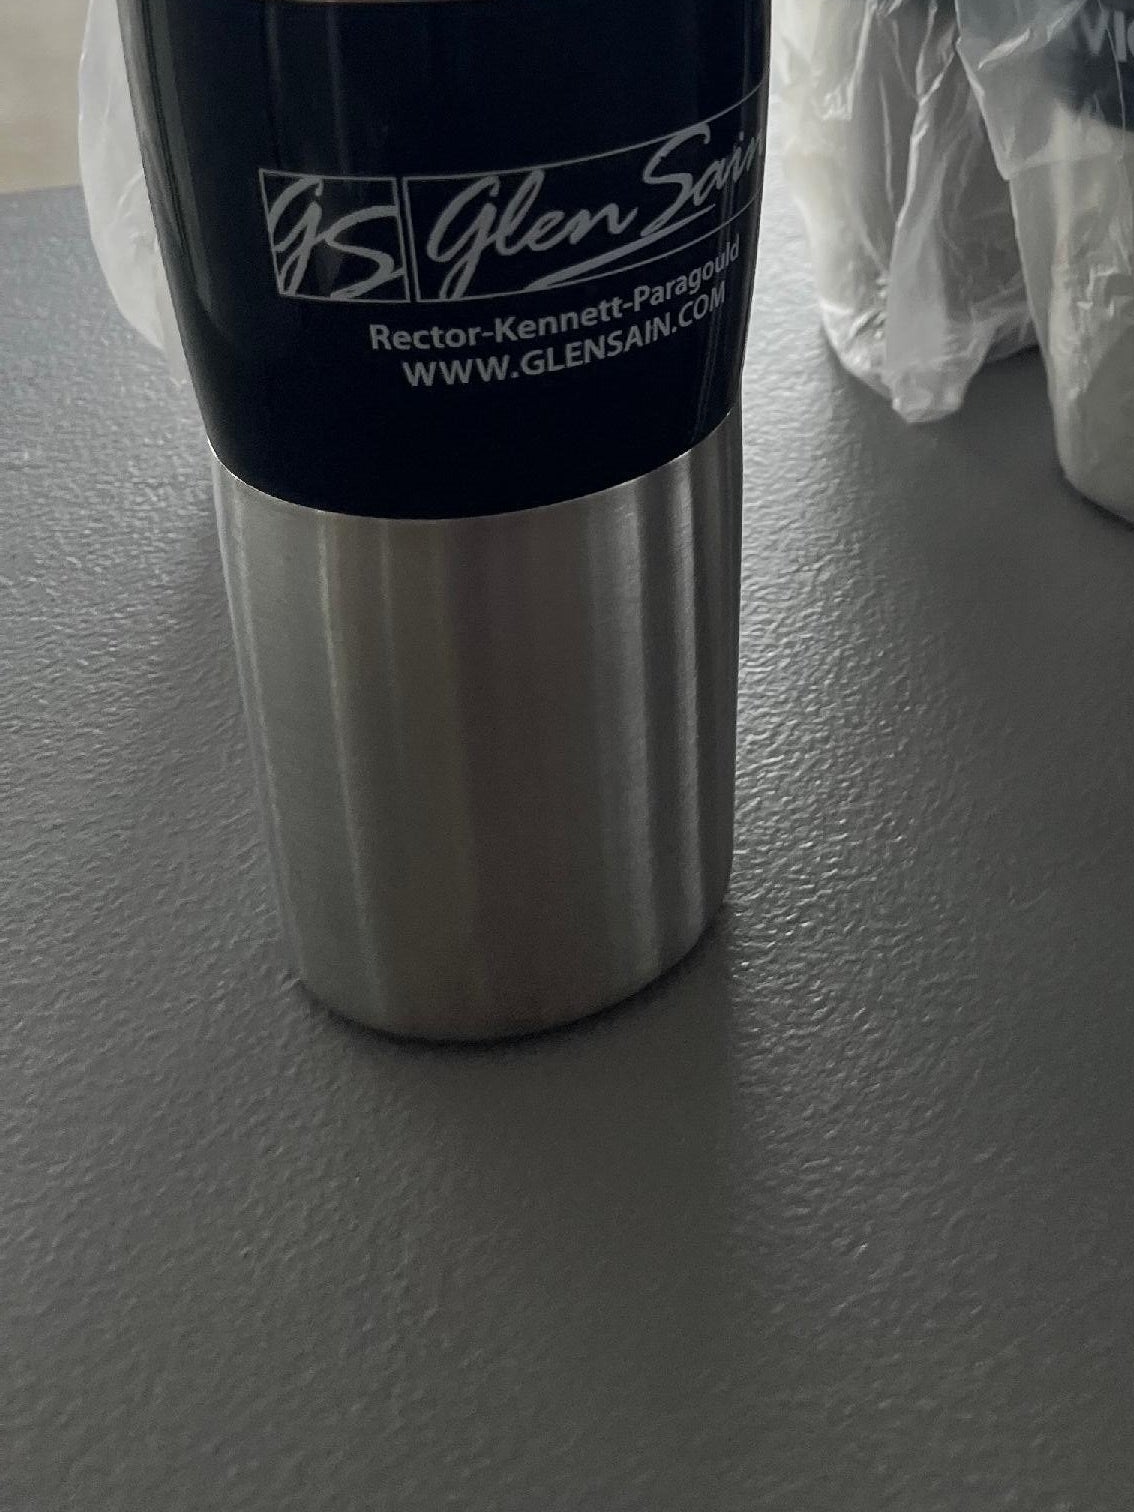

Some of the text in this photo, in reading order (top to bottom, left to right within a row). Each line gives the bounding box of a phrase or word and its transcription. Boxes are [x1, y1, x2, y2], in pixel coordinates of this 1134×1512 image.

[427, 170, 640, 300] Glen
[640, 122, 763, 230] Sain
[369, 235, 740, 351] Rector-Kennett-Paragould
[403, 280, 727, 387] WWW.GLENSAIN.COM
